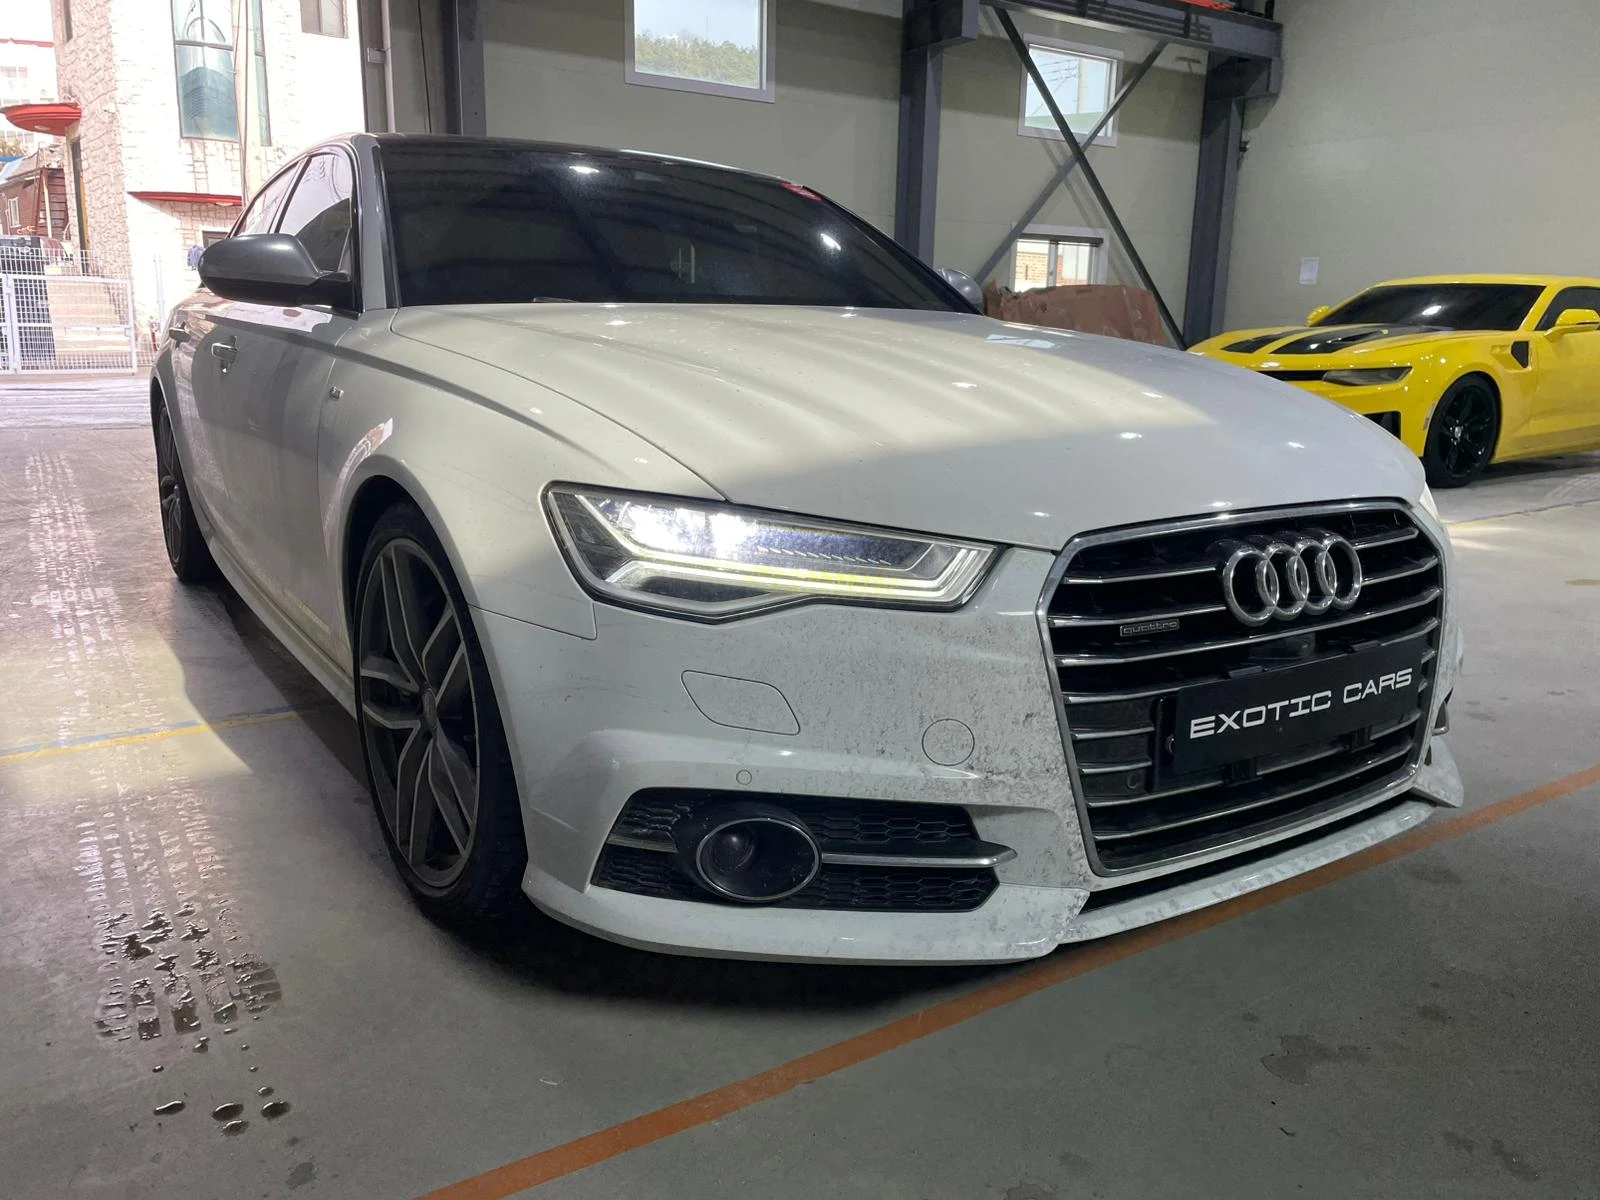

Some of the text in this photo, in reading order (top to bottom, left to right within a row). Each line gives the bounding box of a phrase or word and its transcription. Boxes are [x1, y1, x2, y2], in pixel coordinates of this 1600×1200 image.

[1123, 621, 1178, 634] quattro
[1189, 668, 1413, 740] EXOTIC CARS
